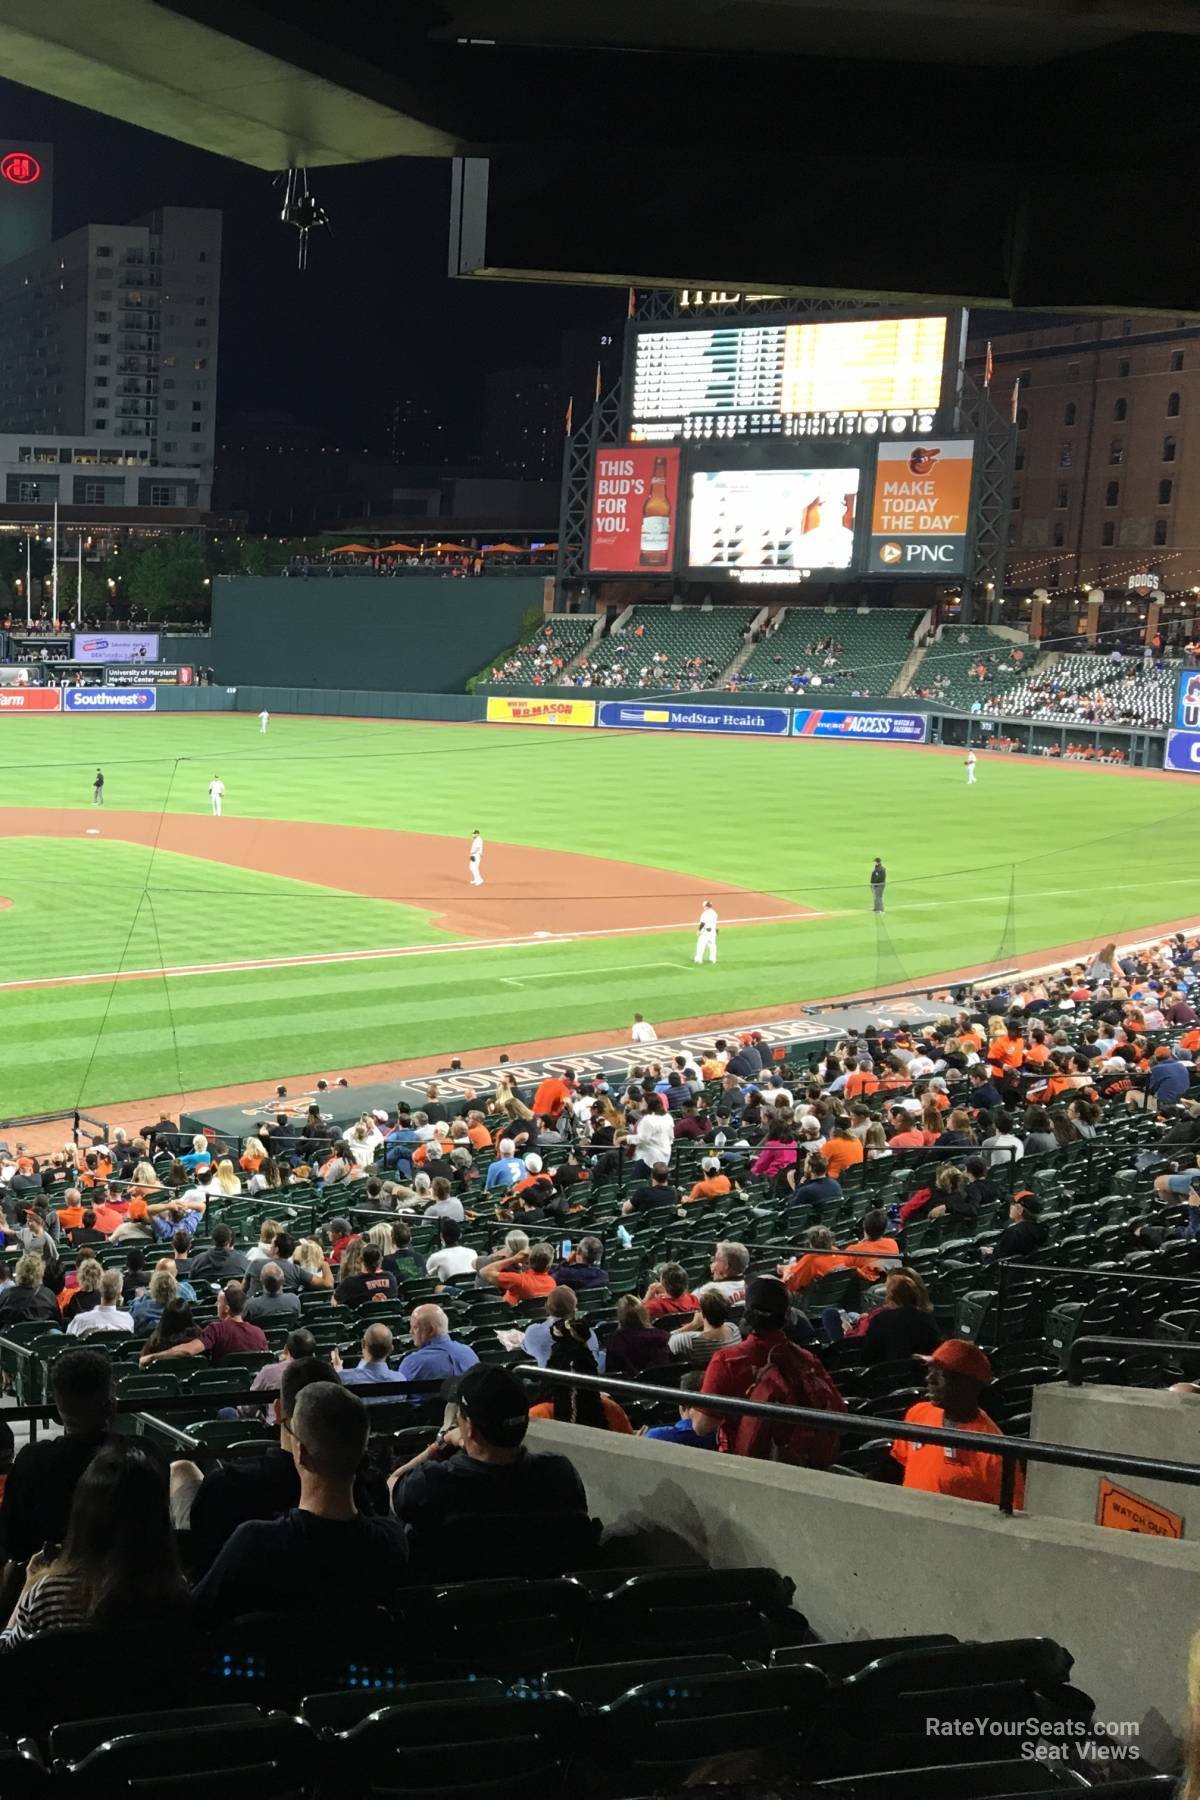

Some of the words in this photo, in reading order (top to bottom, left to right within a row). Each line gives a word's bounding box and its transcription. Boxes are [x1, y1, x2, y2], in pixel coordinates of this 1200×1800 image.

[599, 460, 635, 476] THIS
[598, 479, 645, 495] BUD'S
[883, 481, 936, 496] MAKE
[597, 498, 627, 514] FOR
[881, 498, 939, 513] TODAY
[596, 517, 630, 533] YOU.
[880, 515, 915, 530] THE
[906, 544, 955, 562] PNC
[109, 669, 140, 677] University
[149, 669, 177, 677] Maryland
[74, 692, 138, 705] Southwest
[671, 712, 721, 724] MedStar
[723, 714, 766, 727] Health
[848, 716, 893, 734] ACCESS
[1112, 1502, 1146, 1526] WATCH
[1147, 1521, 1169, 1536] OUT
